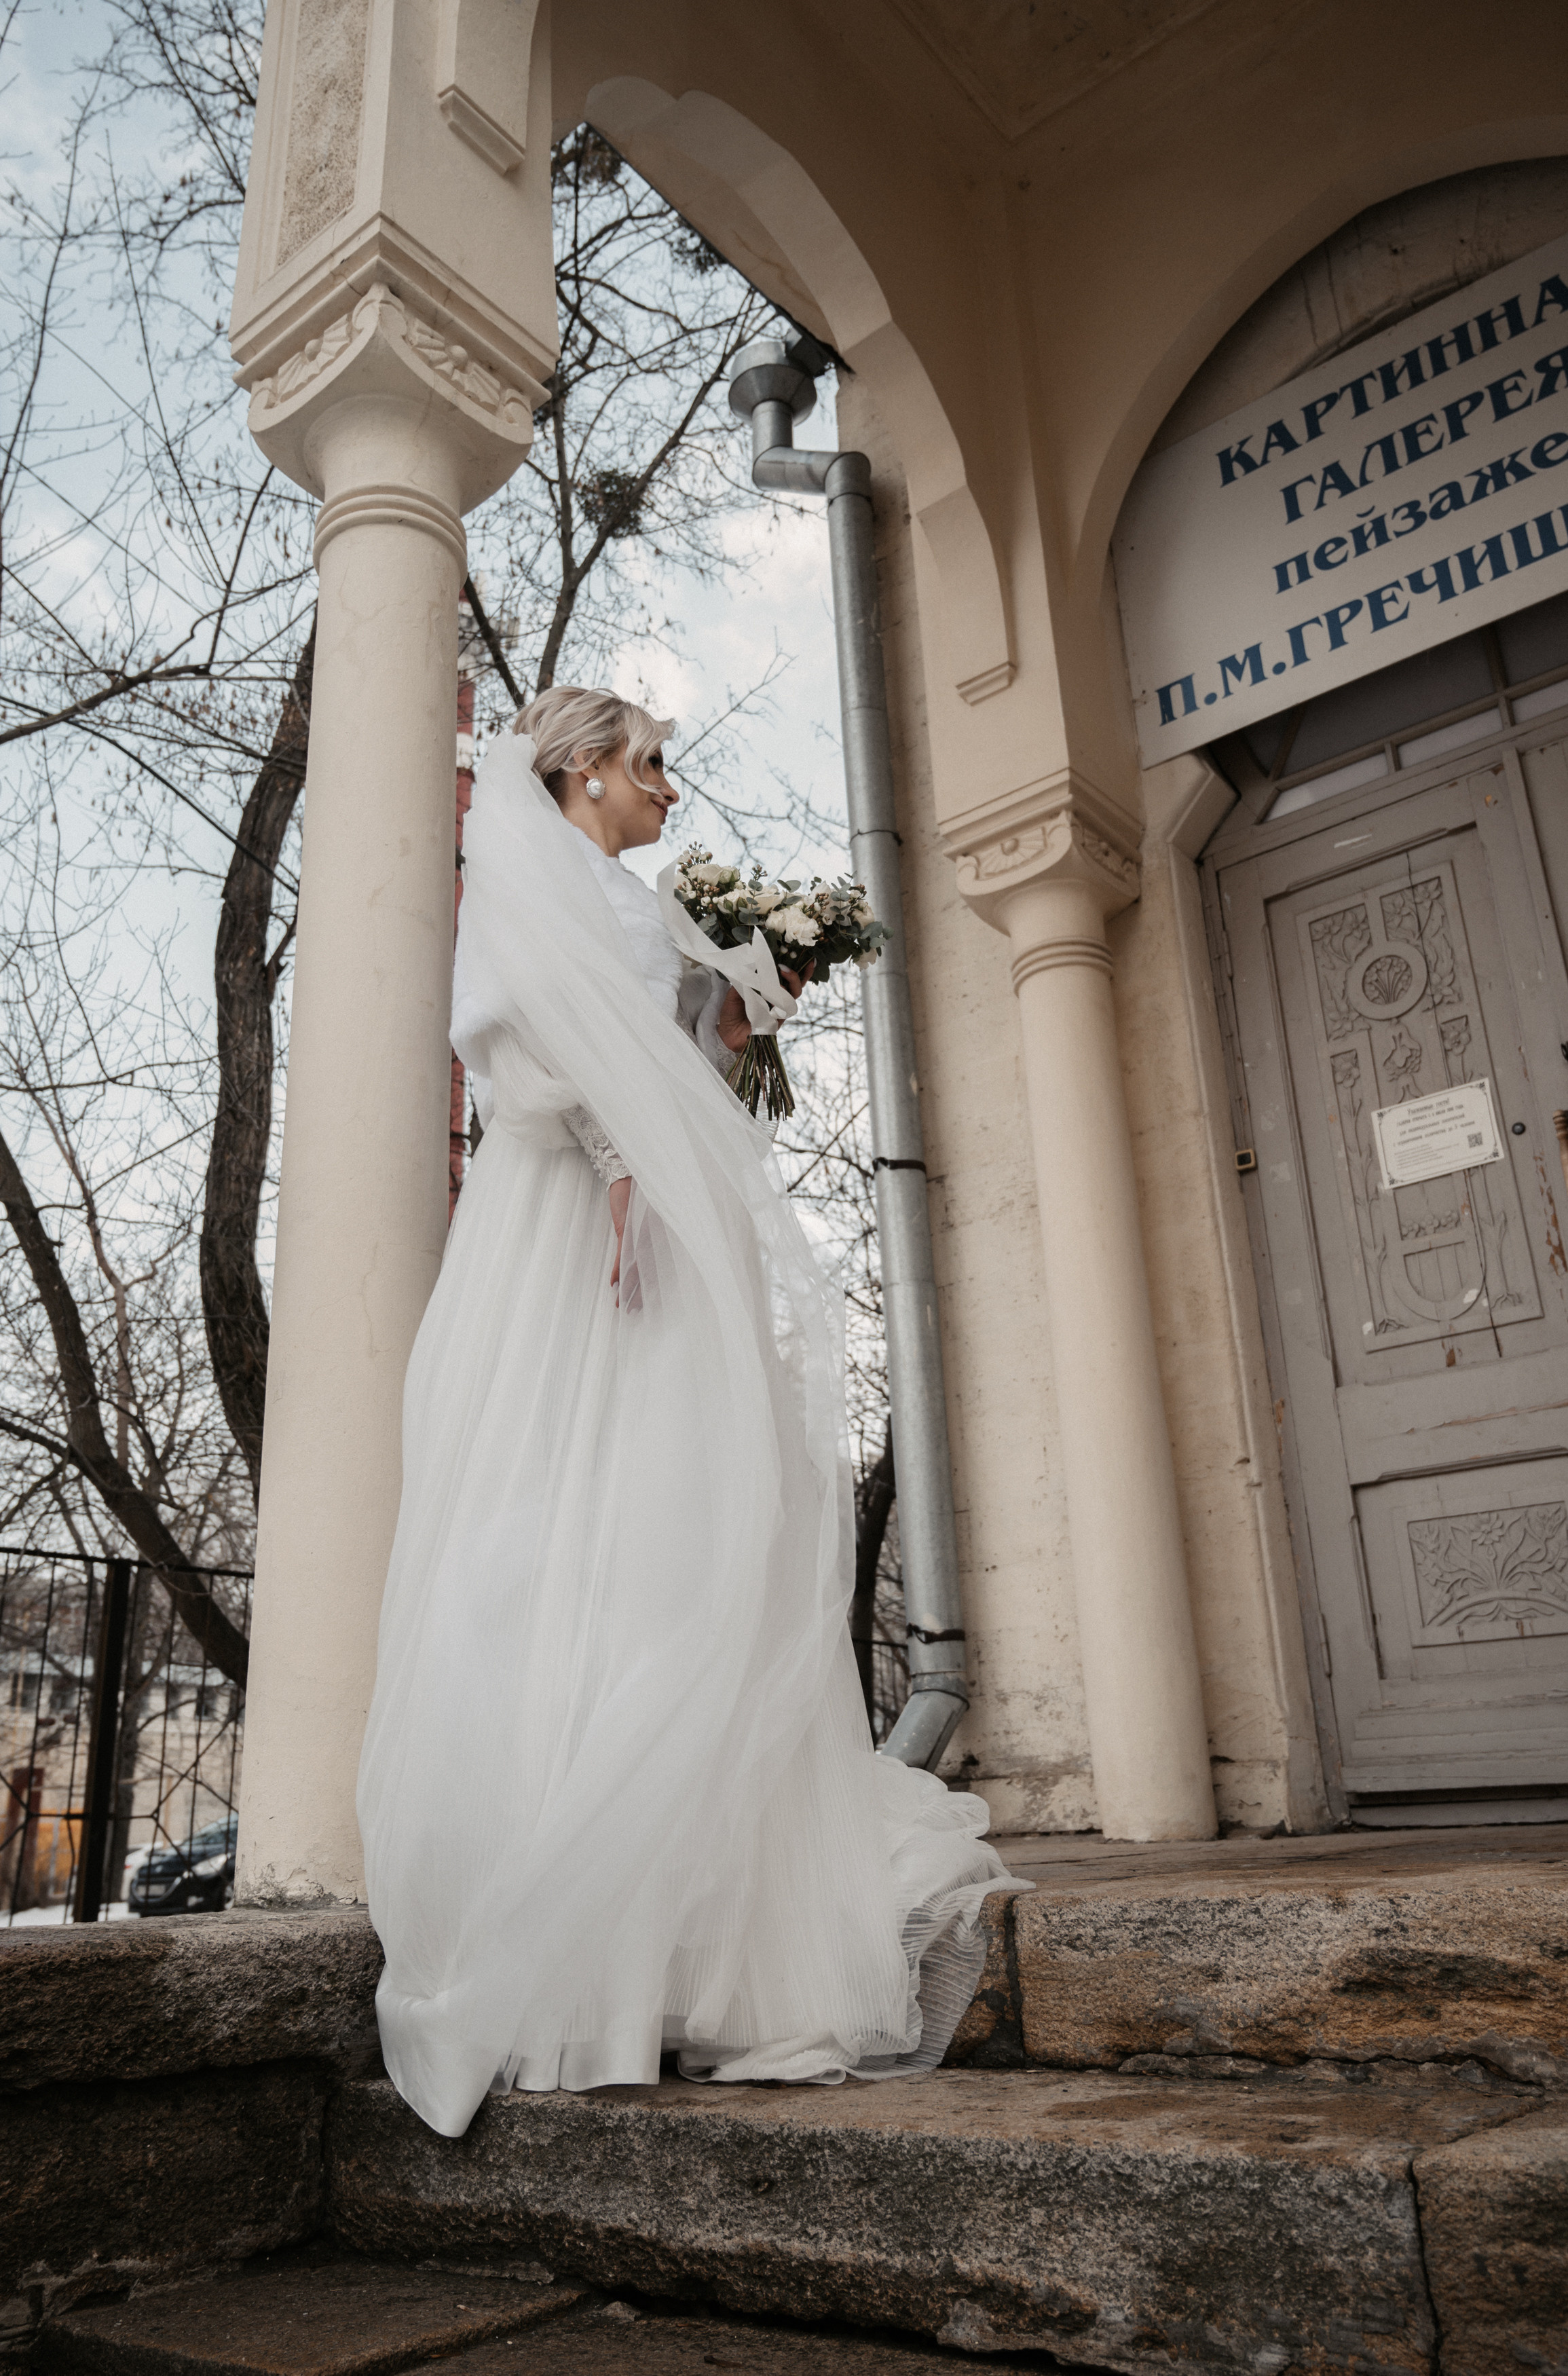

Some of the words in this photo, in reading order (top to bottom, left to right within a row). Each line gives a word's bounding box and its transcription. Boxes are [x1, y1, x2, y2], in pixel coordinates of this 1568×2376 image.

[1215, 274, 1568, 488] КАРТИННА
[1279, 345, 1568, 525] ГАЛЕРЕЯ
[1271, 432, 1568, 595] пейзаже
